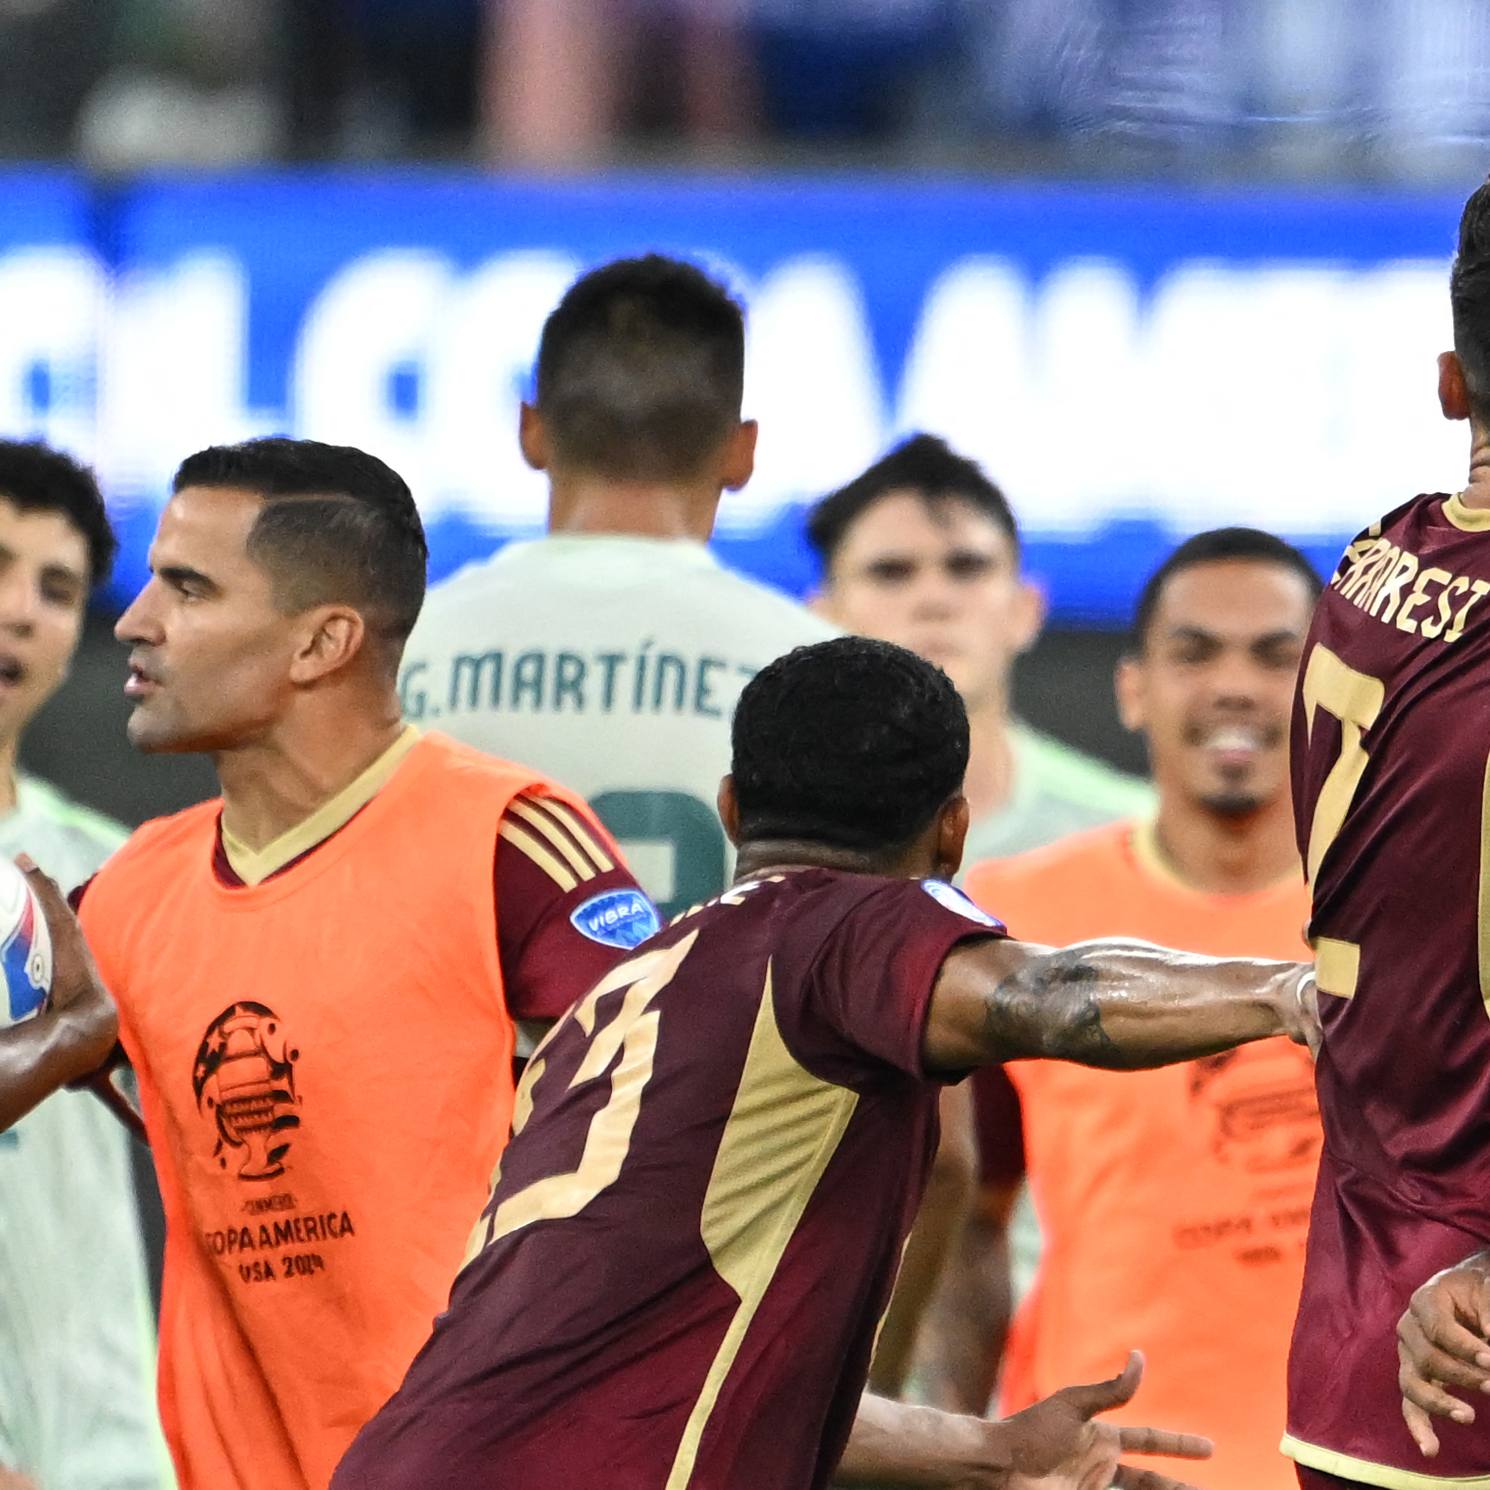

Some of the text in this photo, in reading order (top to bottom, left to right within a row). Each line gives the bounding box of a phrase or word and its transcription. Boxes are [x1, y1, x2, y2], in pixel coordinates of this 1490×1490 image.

[588, 902, 644, 932] VIBRA
[259, 1210, 355, 1250] AMERICA
[238, 1259, 276, 1284] USA
